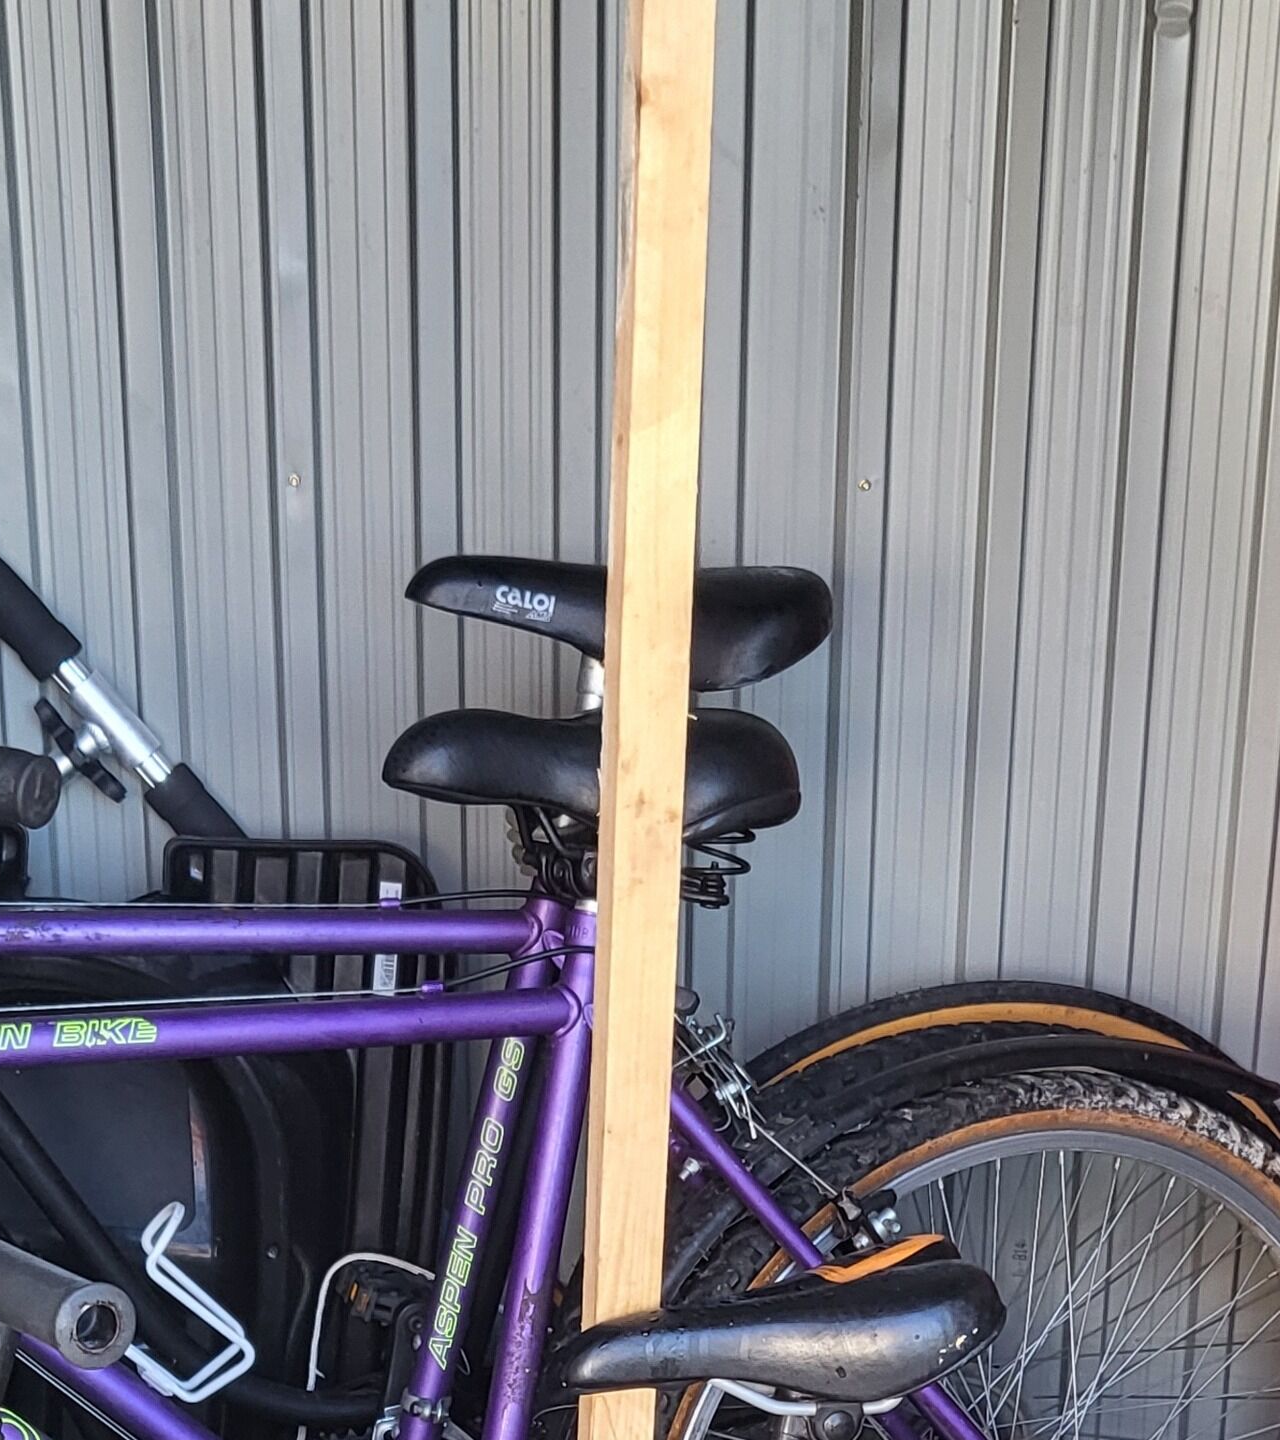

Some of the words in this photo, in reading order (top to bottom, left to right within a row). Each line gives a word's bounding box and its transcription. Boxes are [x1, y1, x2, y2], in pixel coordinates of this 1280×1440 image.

[52, 1016, 158, 1049] BIKE
[428, 1224, 478, 1371] ASPEN
[464, 1116, 505, 1216] PRO
